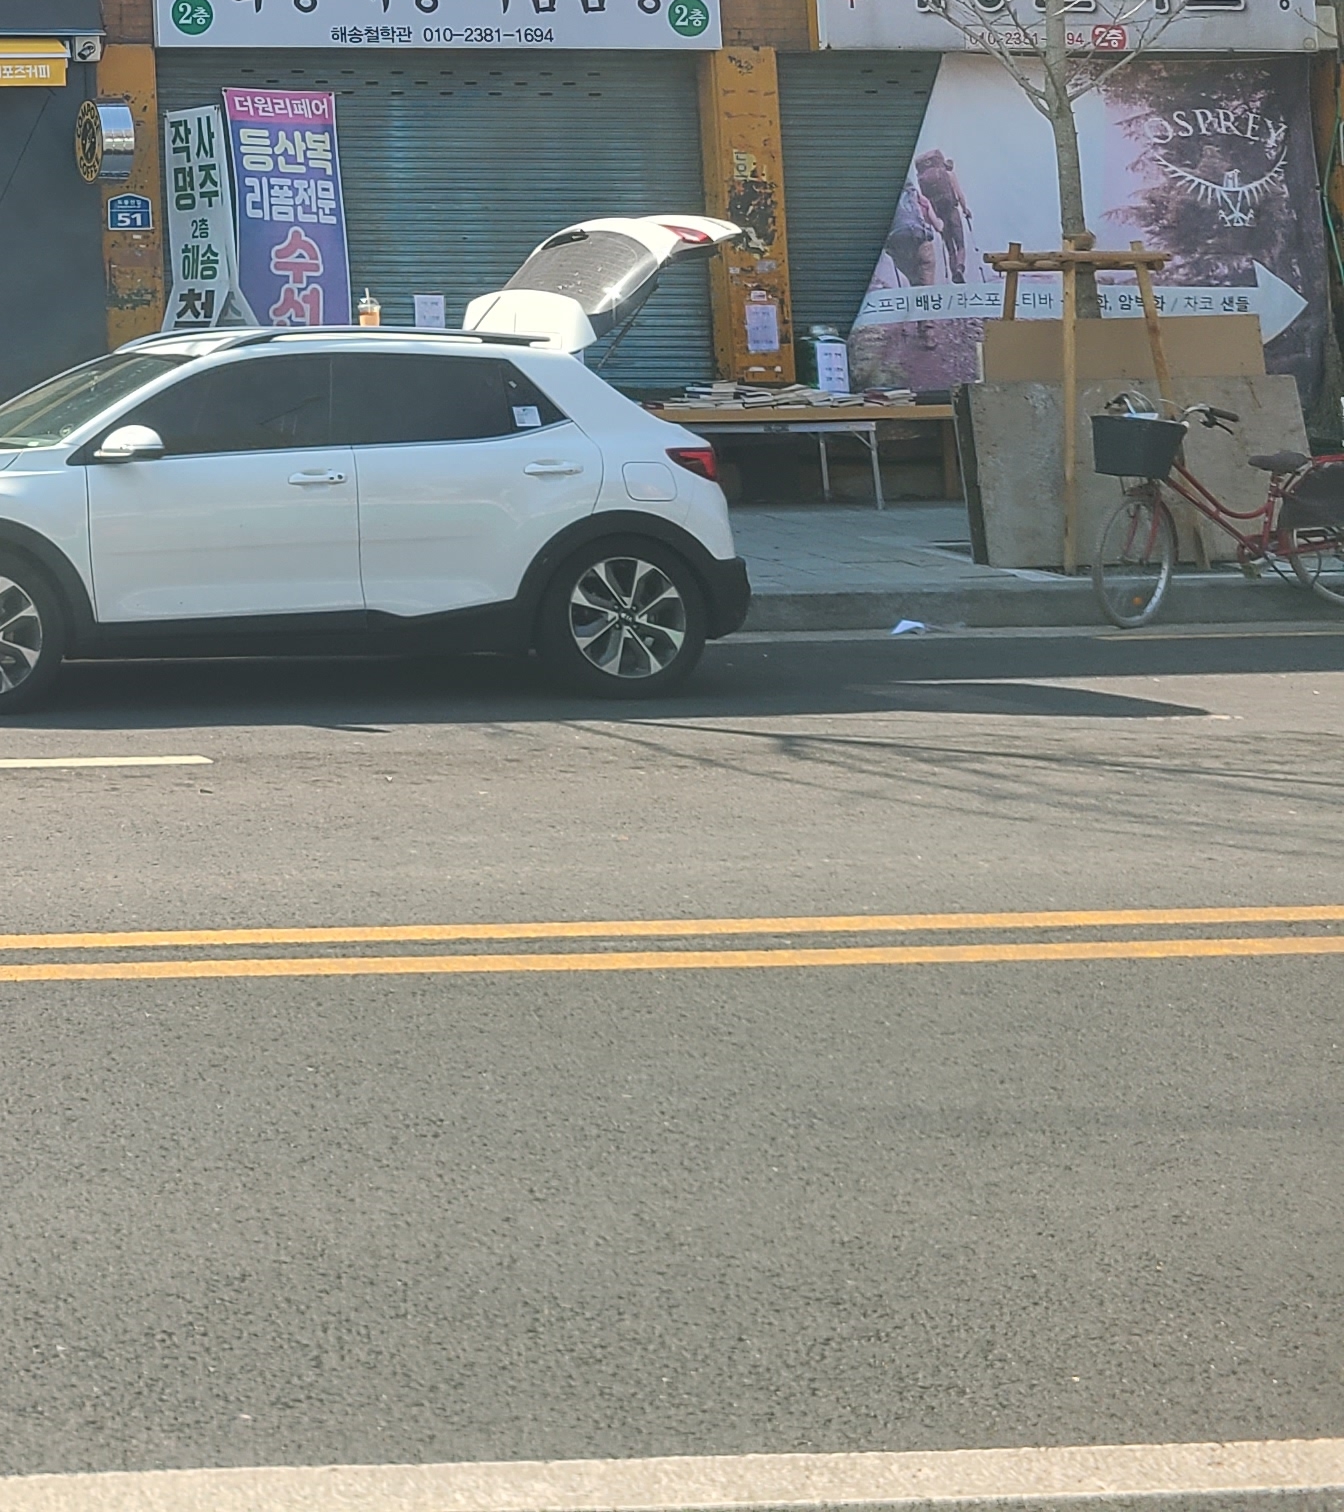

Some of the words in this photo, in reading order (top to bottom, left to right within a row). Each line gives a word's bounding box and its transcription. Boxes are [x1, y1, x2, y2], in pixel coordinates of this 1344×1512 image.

[178, 2, 210, 25] 2층
[675, 4, 706, 27] 2층
[330, 26, 412, 43] 해송철학관
[423, 28, 554, 43] 010-2381-1694
[233, 96, 329, 119] 더원리페어
[1144, 108, 1288, 147] OSPREY
[239, 128, 333, 176] 등산복
[245, 177, 337, 225] 리폼전문
[117, 213, 142, 226] 51
[191, 218, 210, 239] 2층
[181, 243, 219, 281] 해송
[915, 293, 944, 311] 배낭
[957, 292, 1054, 309] 라스포티바
